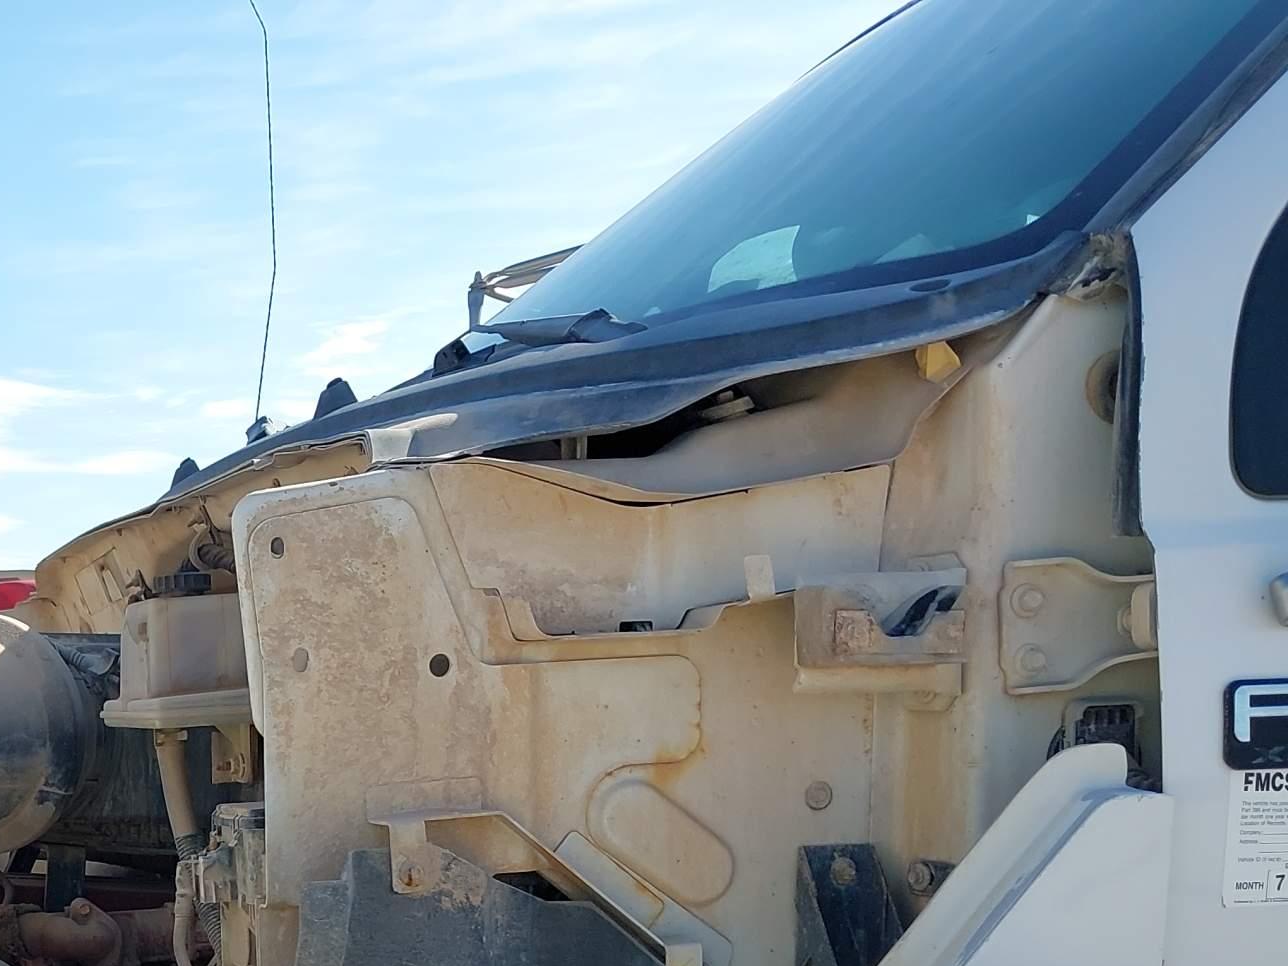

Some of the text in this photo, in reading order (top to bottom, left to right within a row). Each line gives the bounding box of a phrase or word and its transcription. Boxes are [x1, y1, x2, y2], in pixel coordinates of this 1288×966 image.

[1243, 772, 1288, 792] FMC
[1235, 874, 1286, 891] MONTH 7
